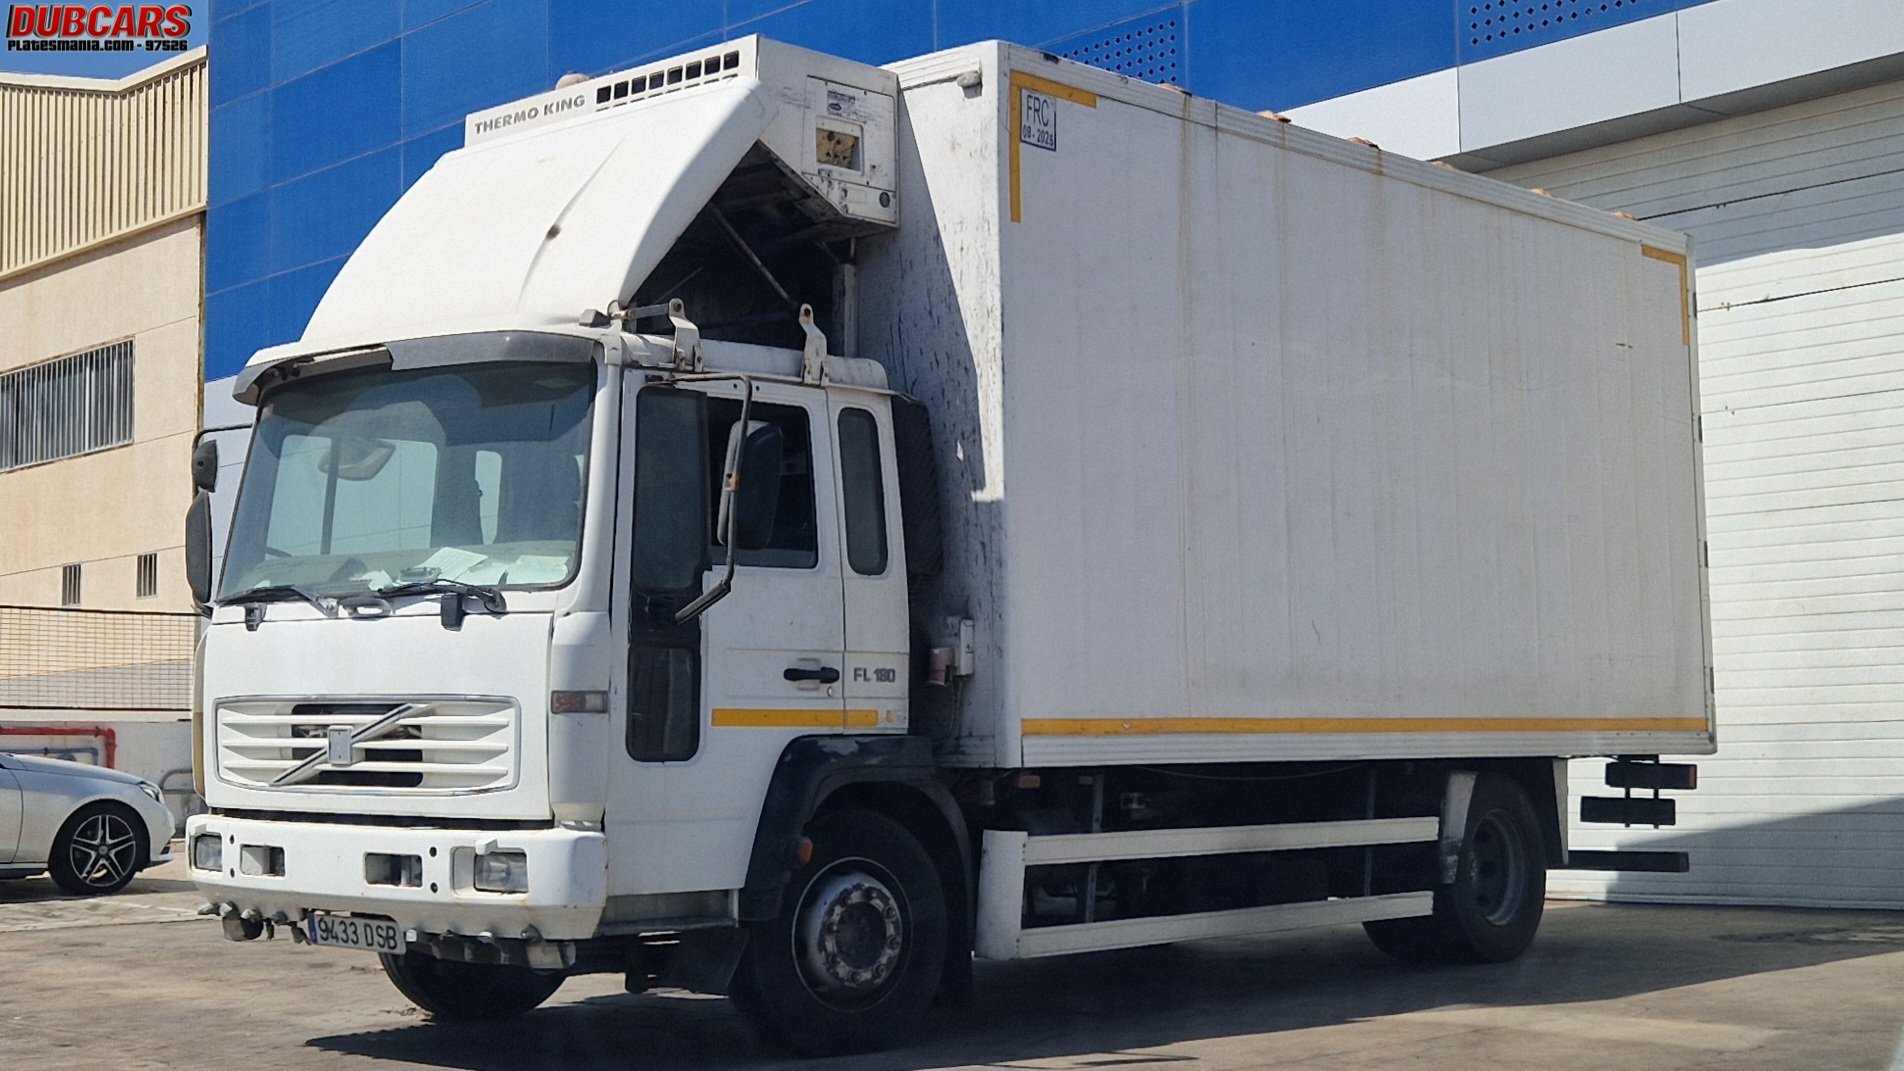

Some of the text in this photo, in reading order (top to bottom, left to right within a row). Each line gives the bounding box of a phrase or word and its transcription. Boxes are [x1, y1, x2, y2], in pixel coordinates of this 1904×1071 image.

[475, 95, 585, 134] THERMO KING
[1026, 94, 1050, 127] FRC
[853, 667, 896, 683] FL 180
[318, 917, 398, 950] 9433 DSB
